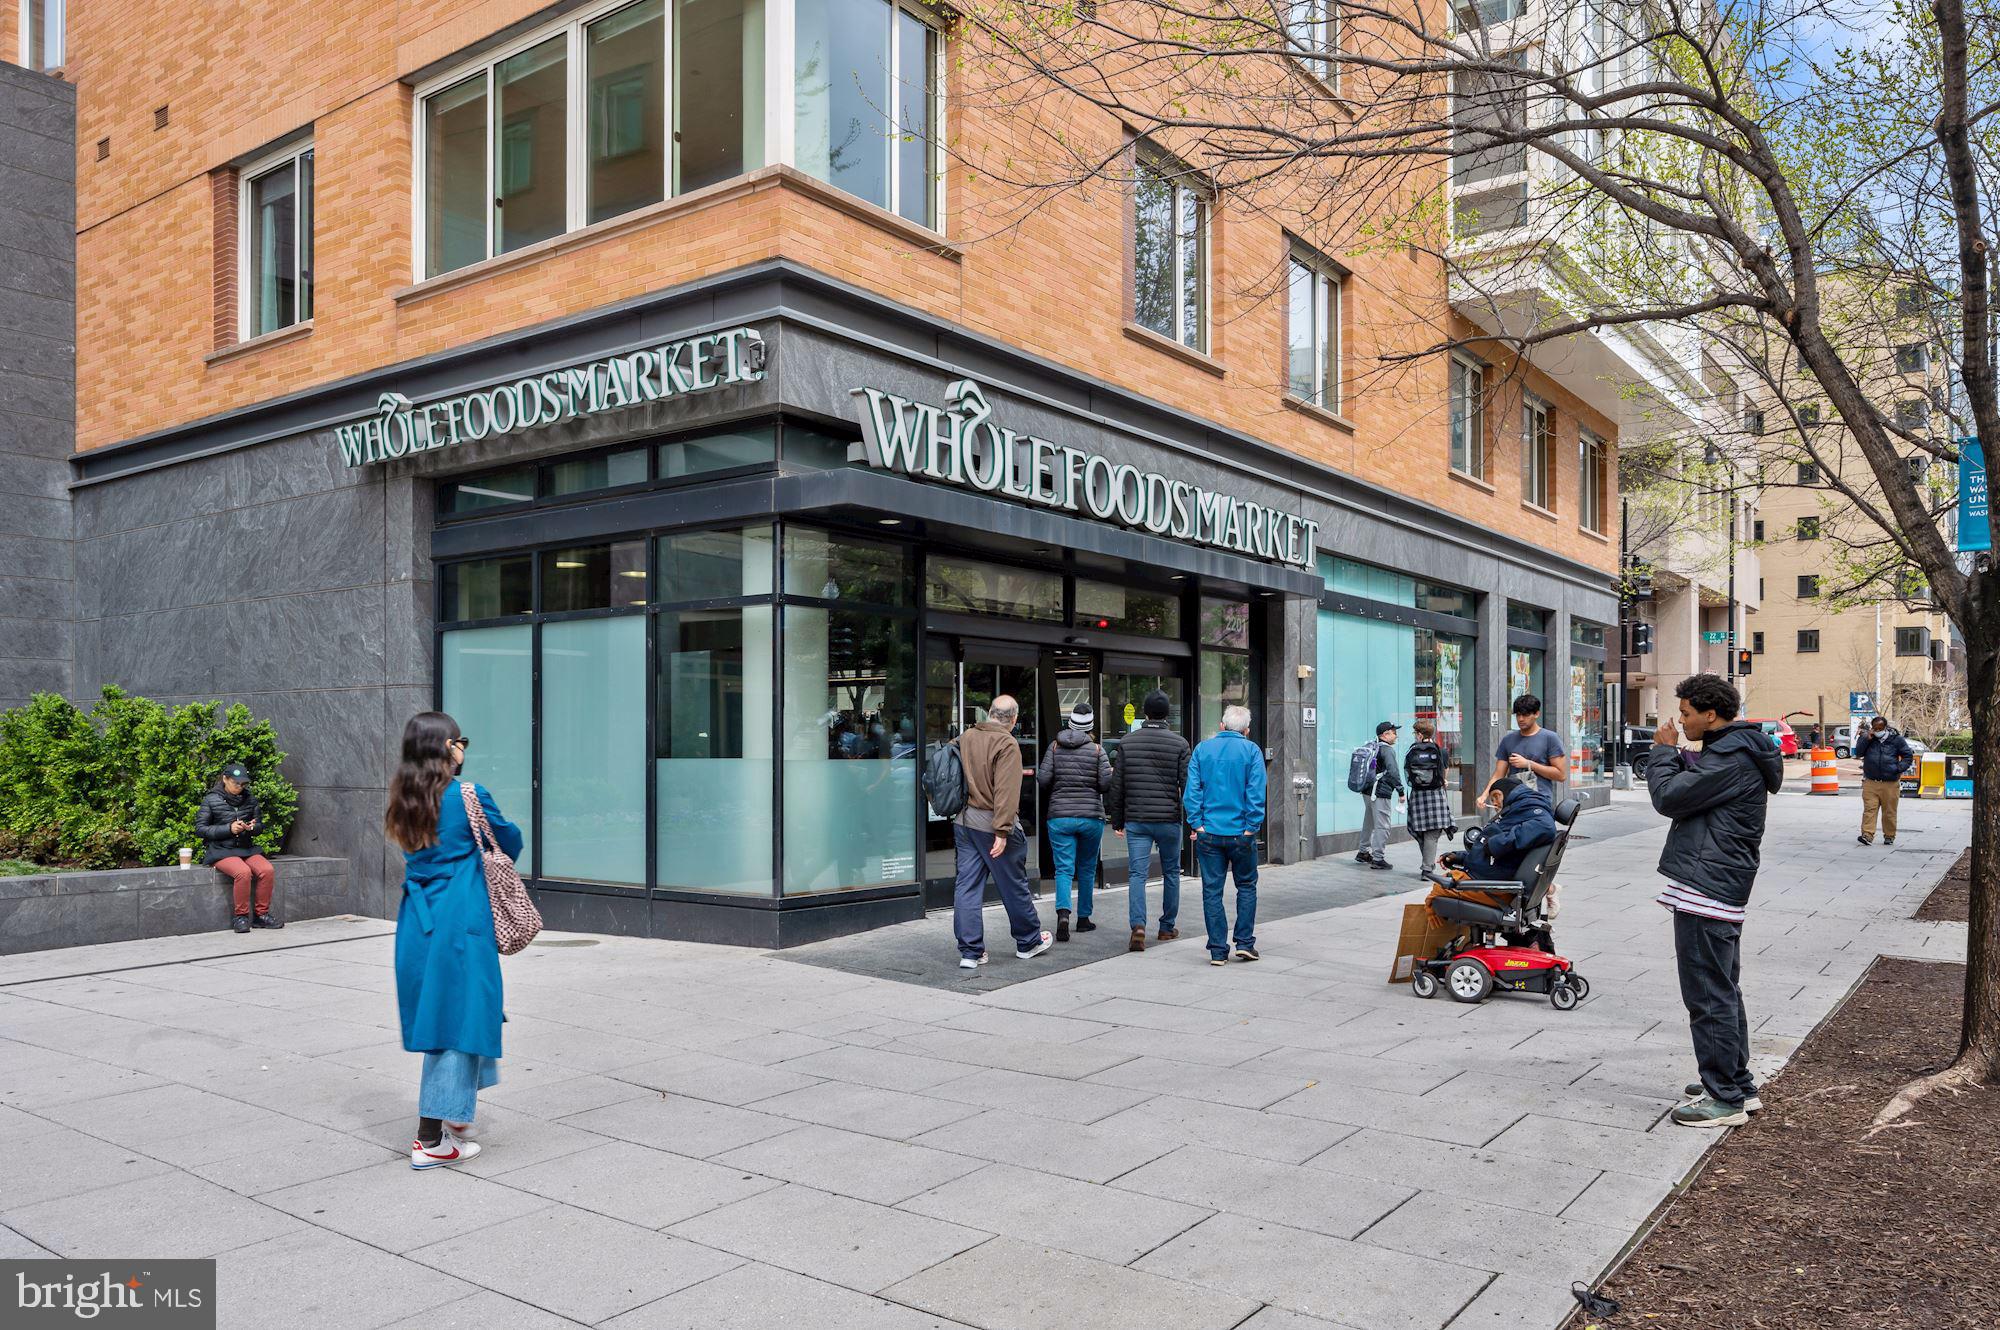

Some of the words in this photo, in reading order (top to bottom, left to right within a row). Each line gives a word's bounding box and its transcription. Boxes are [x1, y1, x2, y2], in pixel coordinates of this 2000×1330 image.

[334, 392, 446, 468] WHOLE
[445, 371, 562, 445] FOODS
[565, 327, 748, 417] MARKET
[862, 380, 1058, 505] WHOLE
[1058, 445, 1193, 540] FOODS
[1193, 486, 1319, 570] MARKET
[1969, 475, 1984, 483] TH
[1969, 495, 1986, 503] UN
[1857, 694, 1869, 708] P
